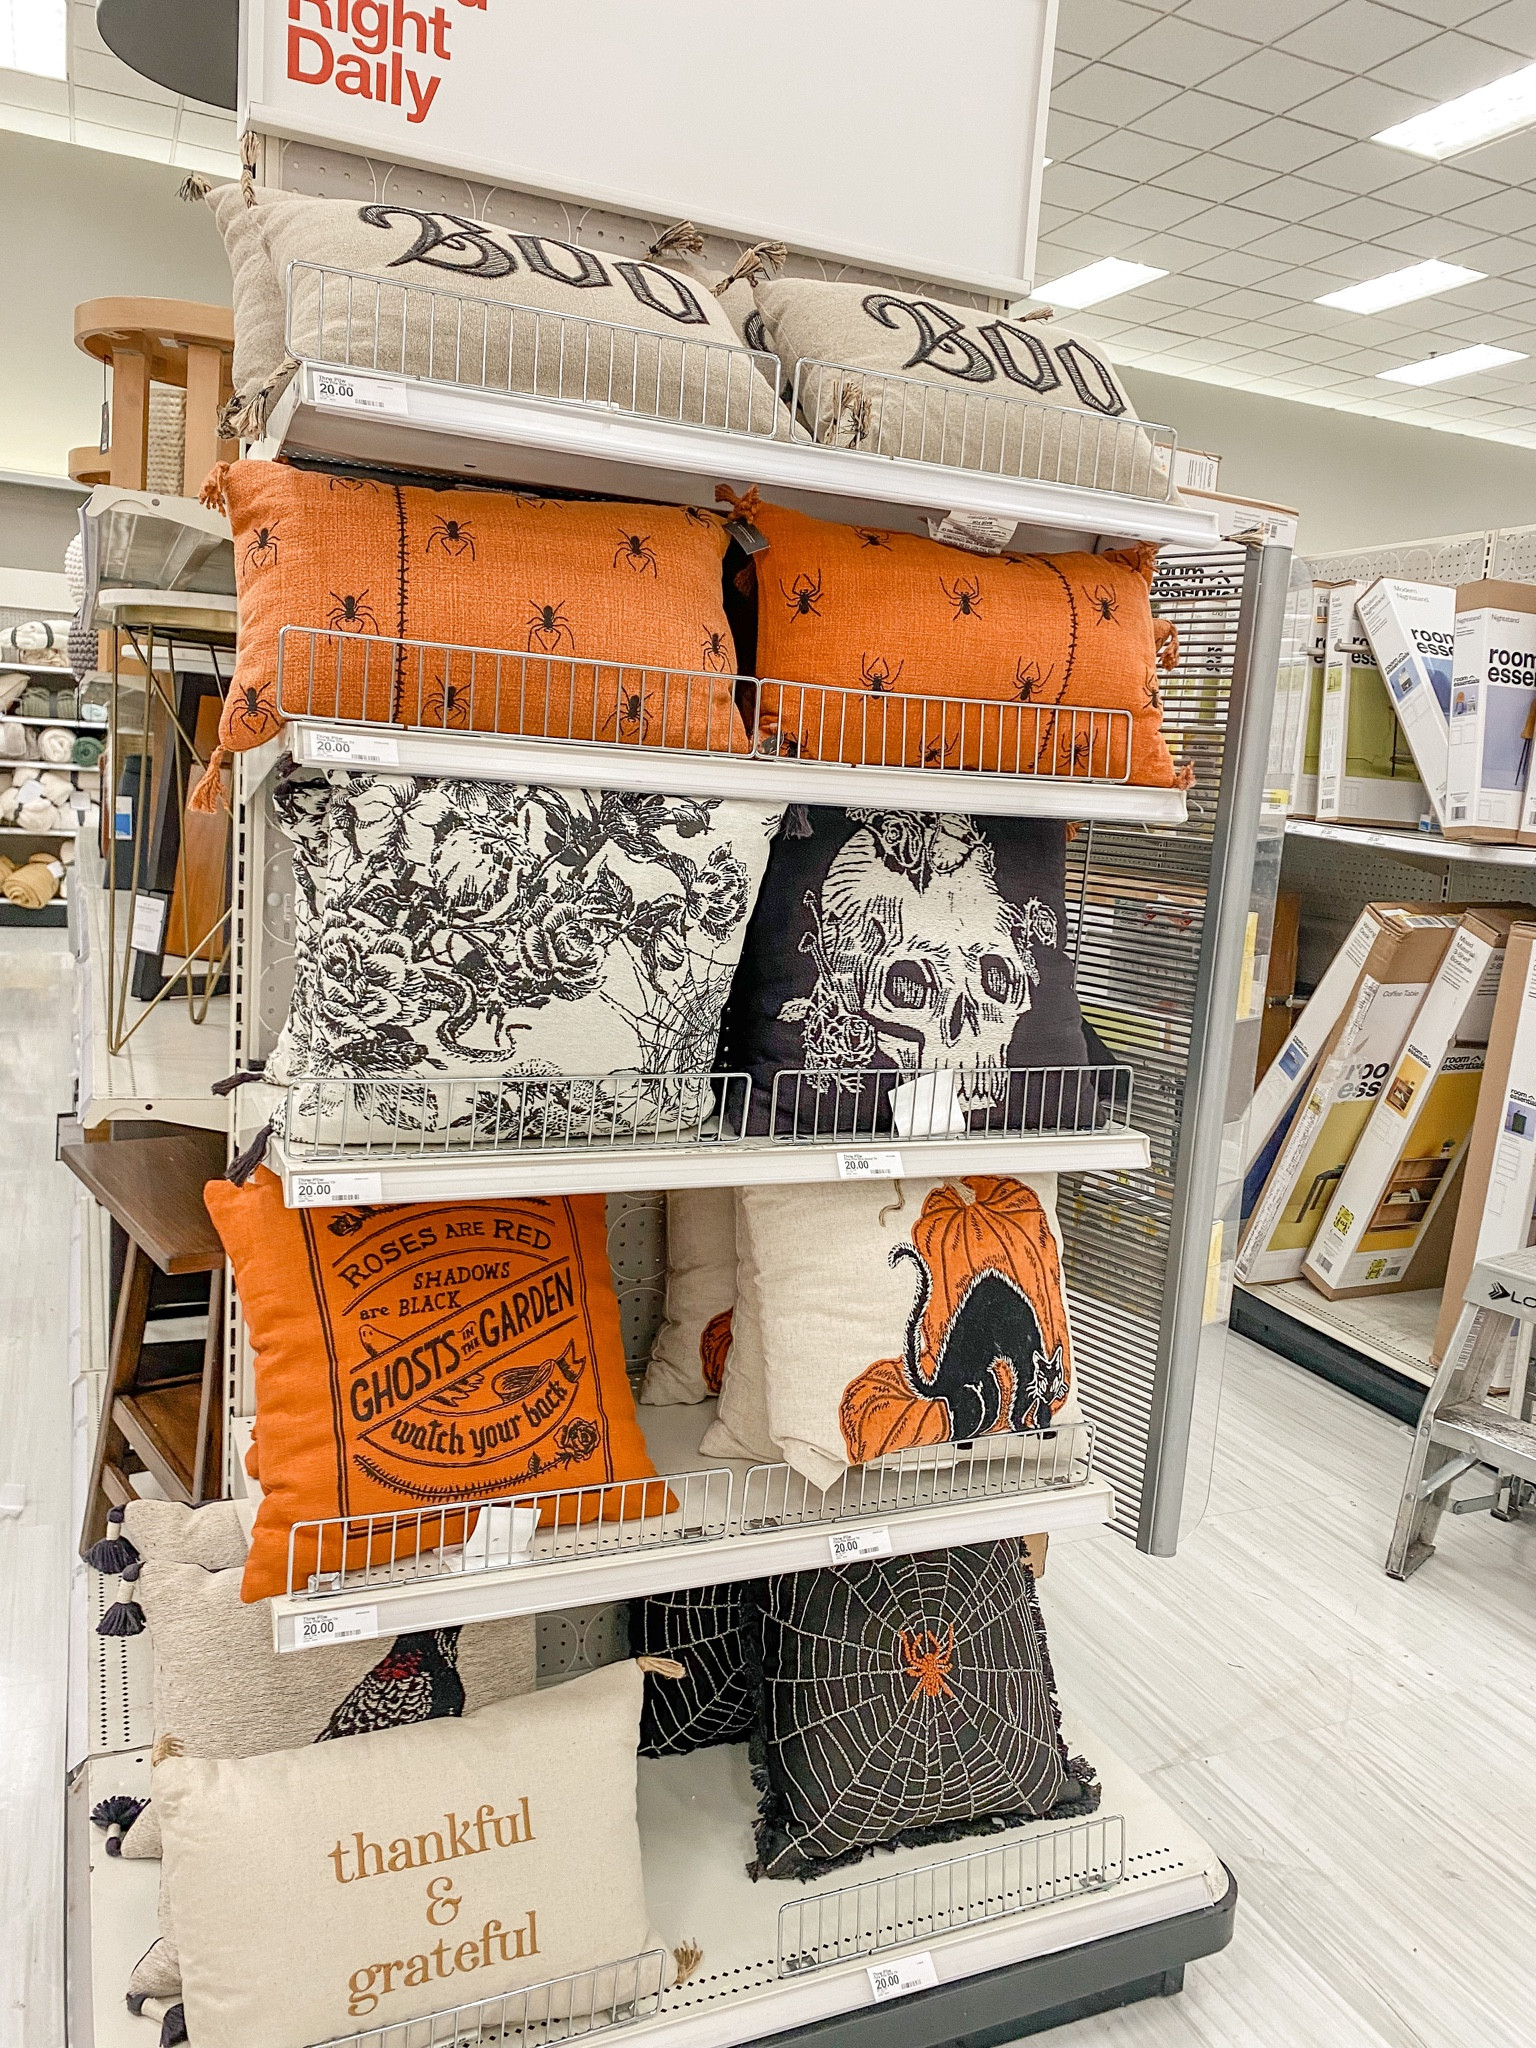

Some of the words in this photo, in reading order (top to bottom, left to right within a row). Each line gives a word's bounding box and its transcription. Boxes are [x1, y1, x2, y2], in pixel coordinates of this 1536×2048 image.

[287, 24, 441, 124] Daily
[320, 383, 354, 398] 20.00
[317, 741, 350, 752] 20.00
[1444, 1056, 1470, 1064] room
[1511, 1088, 1528, 1098] room
[844, 1160, 868, 1170] 20.00
[298, 1184, 331, 1196] 20.00
[338, 1227, 438, 1289] ROSES
[446, 1221, 485, 1240] ARE
[494, 1218, 550, 1250] RED
[413, 1262, 510, 1290] SHADOWS
[360, 1306, 390, 1320] are
[398, 1290, 461, 1318] BLACK
[480, 1267, 574, 1348] GARDEN
[462, 1327, 474, 1340] IN
[461, 1337, 480, 1355] THE
[350, 1329, 460, 1422] GHOSTS
[391, 1418, 466, 1455] watch
[469, 1414, 522, 1457] your
[522, 1380, 568, 1428] back
[834, 1540, 858, 1554] 20.00
[304, 1622, 334, 1636] 20.00
[328, 1796, 536, 1884] thankful
[426, 1876, 462, 1926] &
[348, 1910, 541, 2016] grateful
[875, 1974, 900, 1990] 20.00
